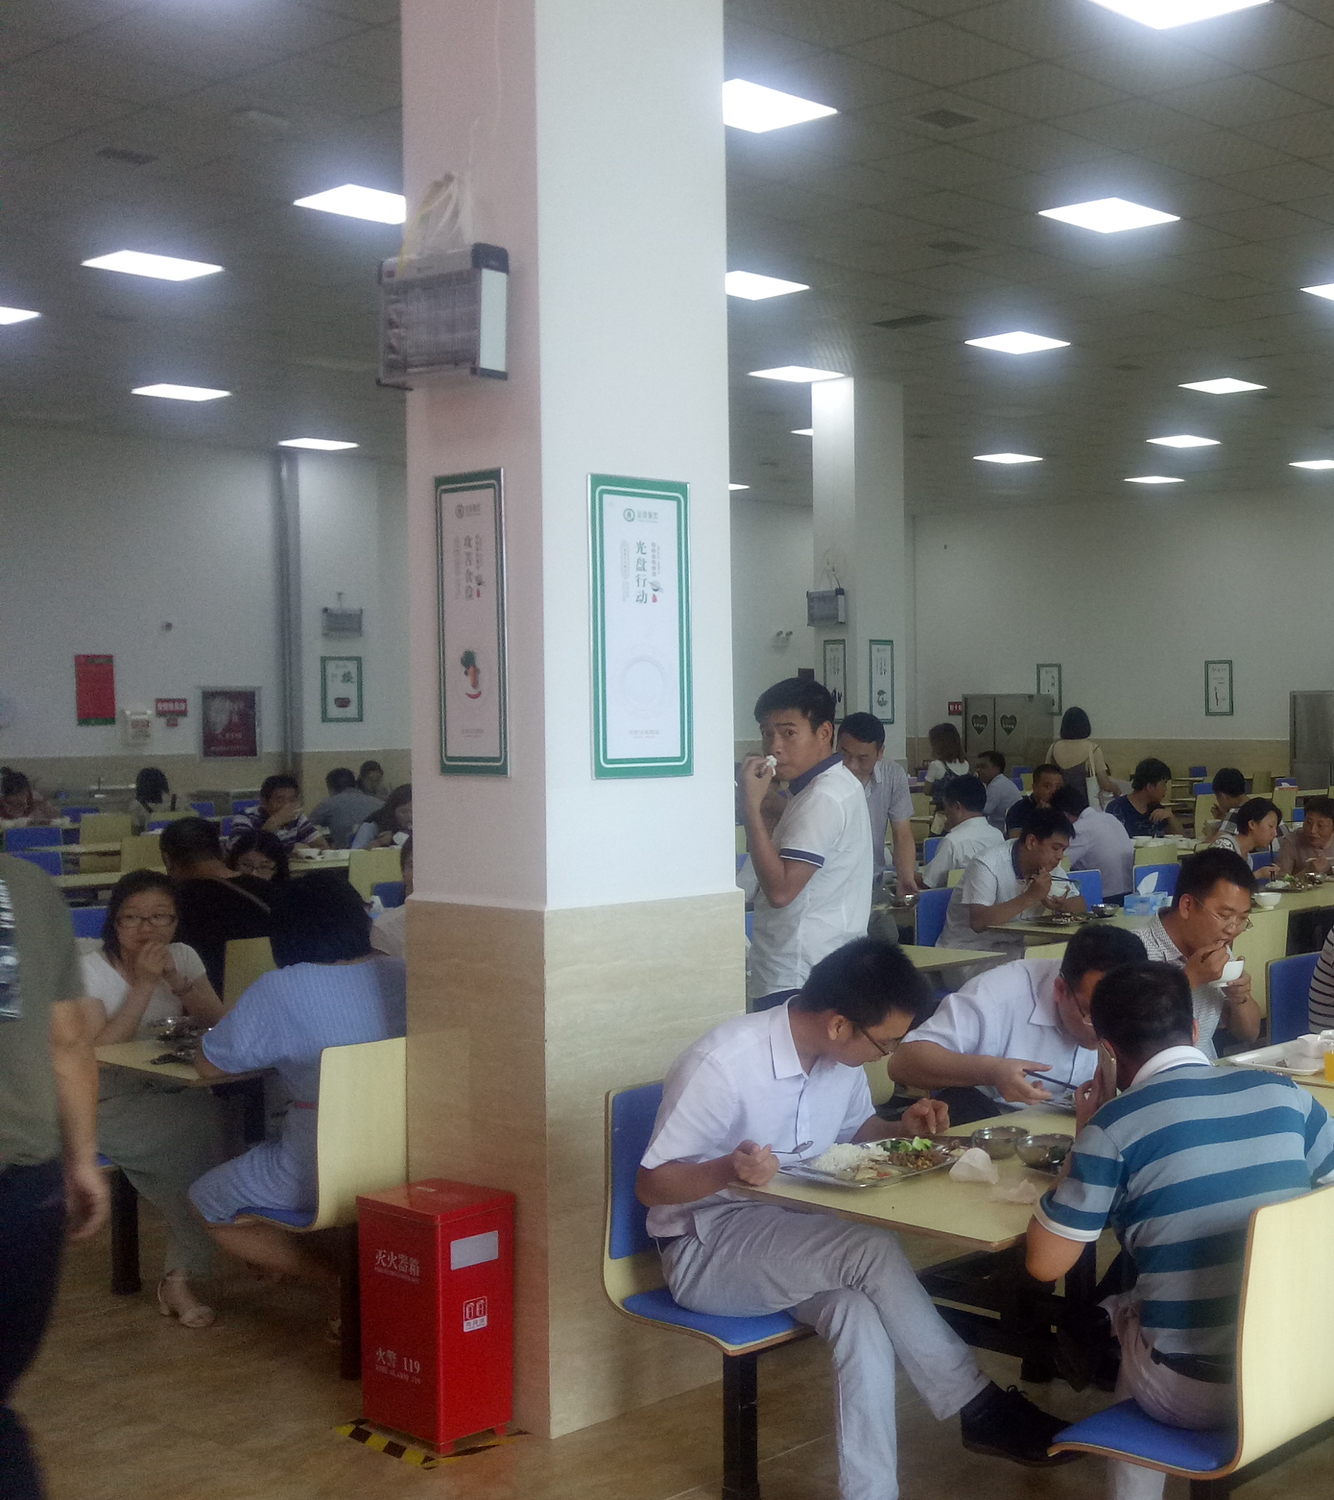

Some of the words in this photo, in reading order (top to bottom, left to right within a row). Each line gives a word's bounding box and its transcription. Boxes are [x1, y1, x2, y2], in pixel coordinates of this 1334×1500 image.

[635, 540, 648, 605] 光盘行动
[375, 1249, 419, 1277] 灭火器箱
[375, 1347, 397, 1369] 火警
[403, 1357, 421, 1374] 119
